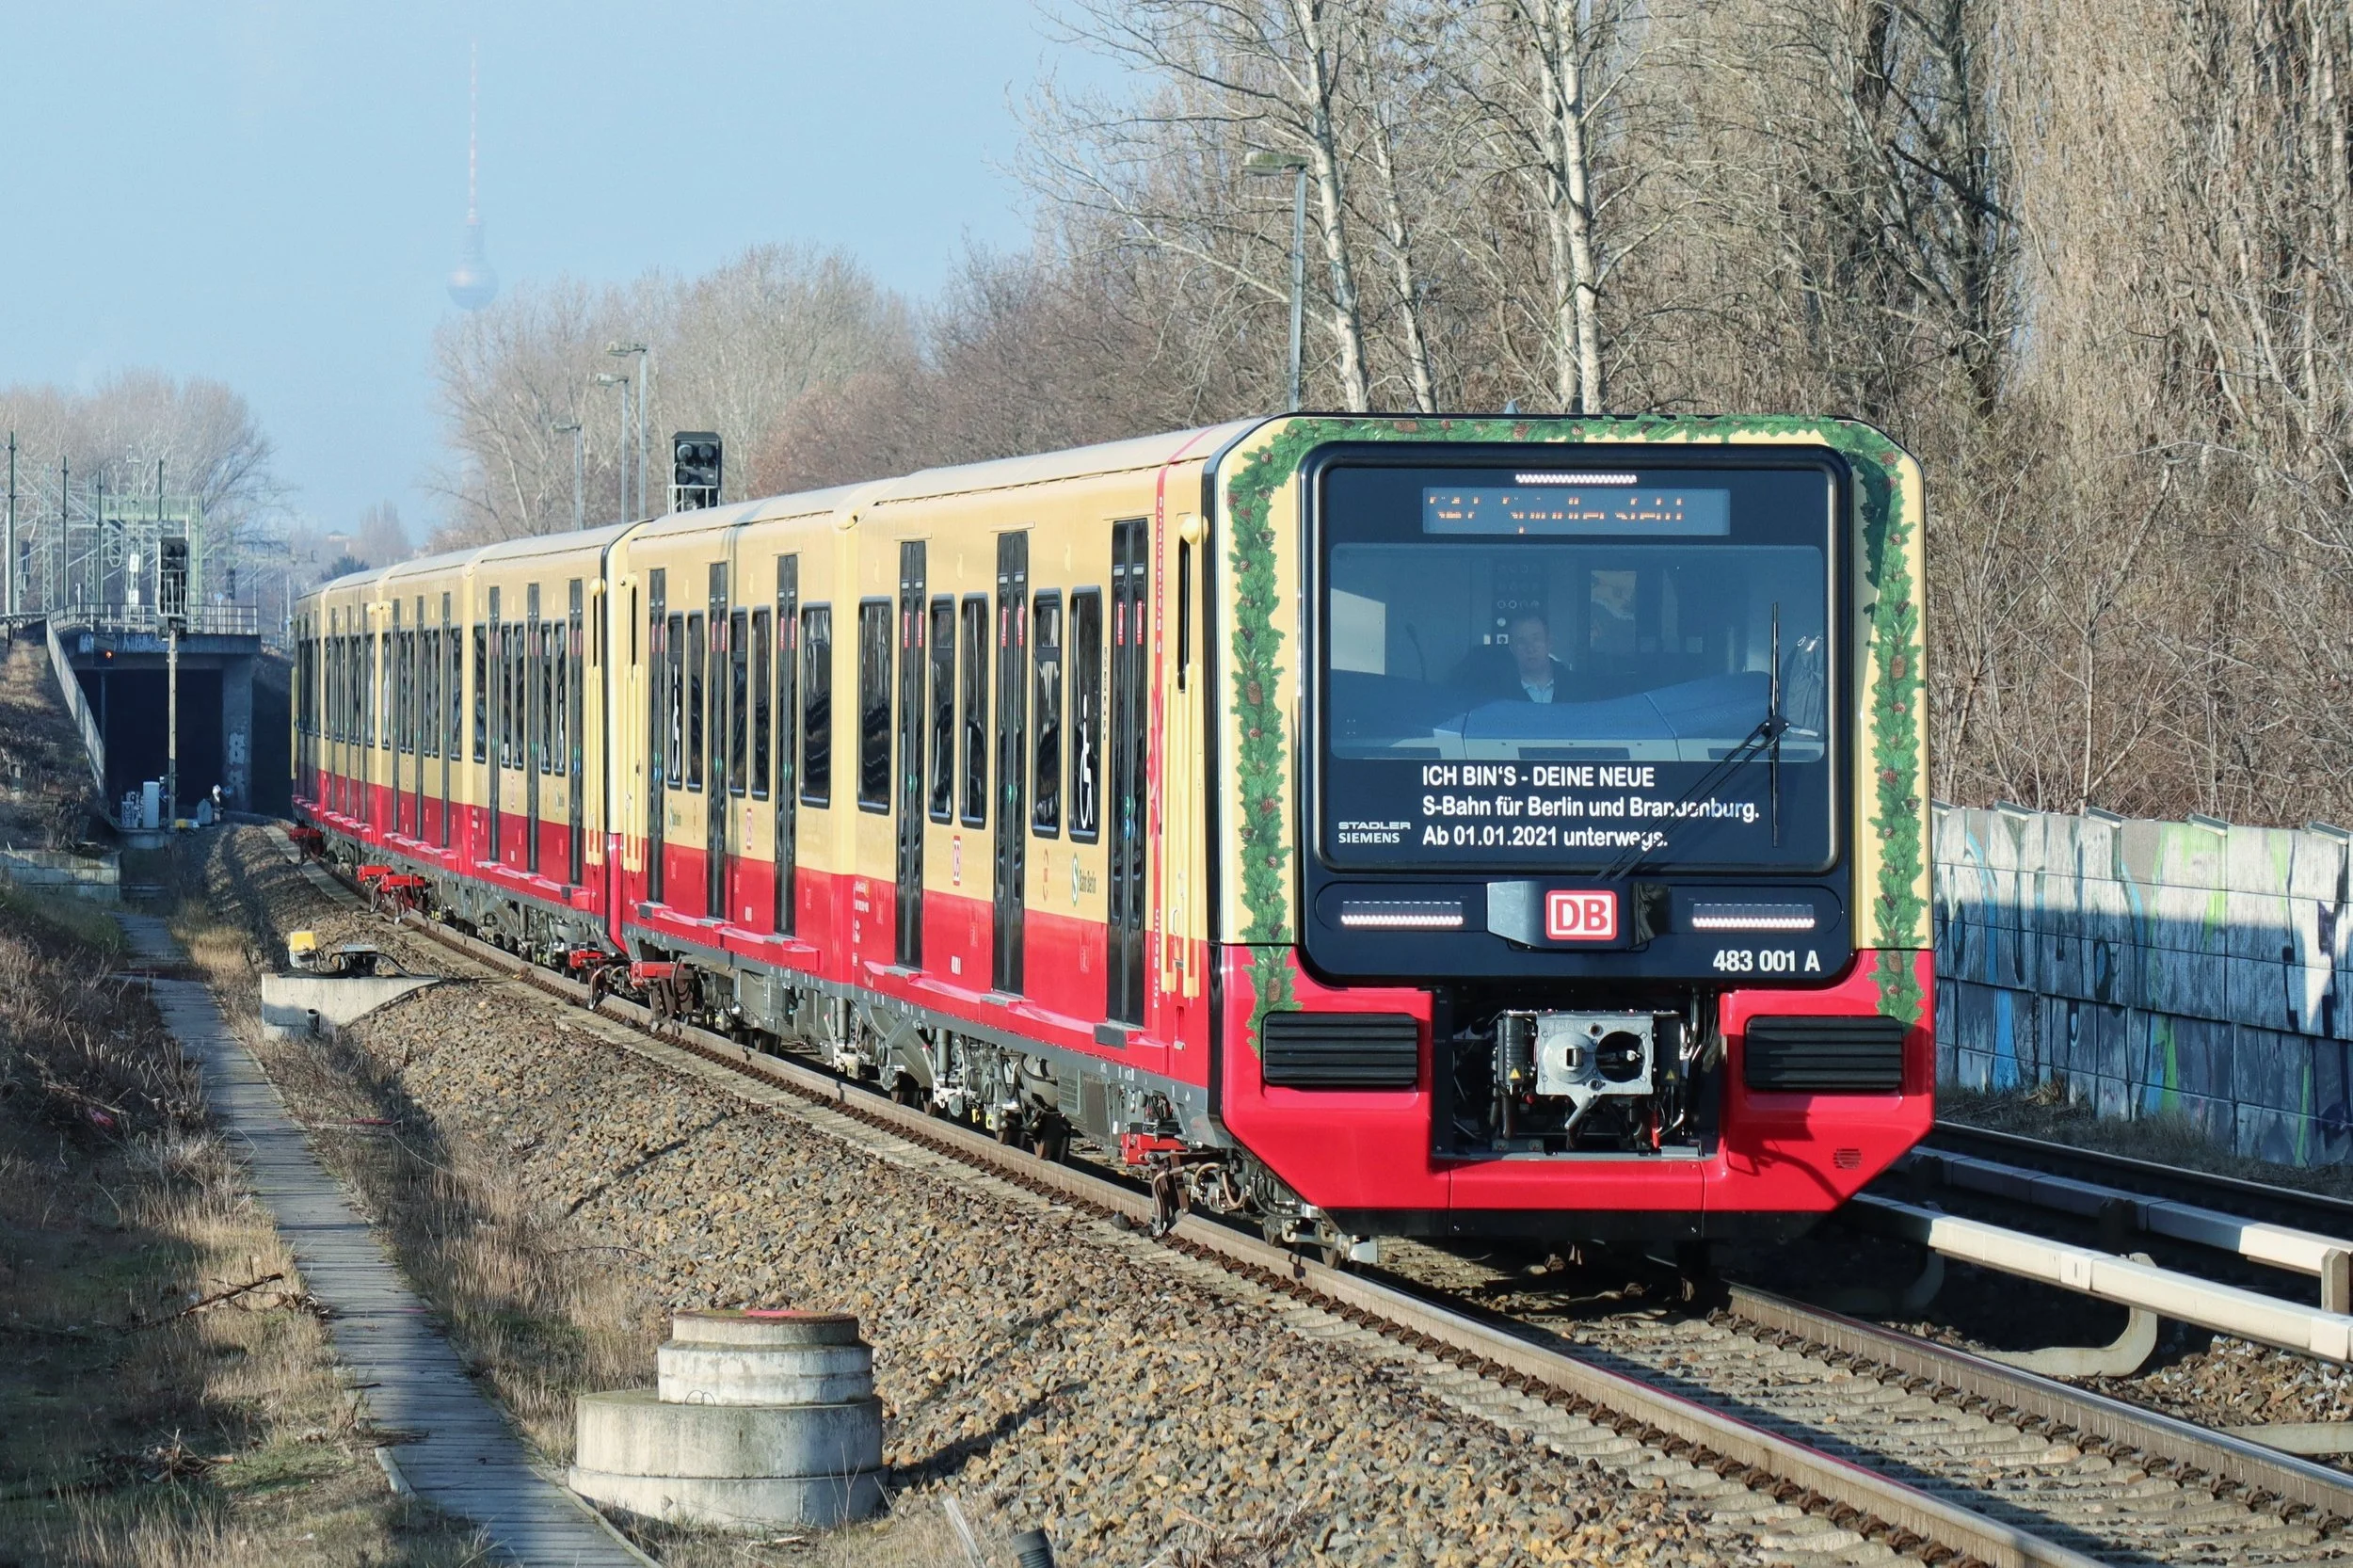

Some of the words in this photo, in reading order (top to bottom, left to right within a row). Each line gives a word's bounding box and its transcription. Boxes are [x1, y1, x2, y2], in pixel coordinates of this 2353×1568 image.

[1422, 764, 1458, 787] ICH
[1532, 765, 1594, 787] DEINE
[1599, 766, 1656, 788] NEUE
[1422, 794, 1491, 817] S-Bahn
[1495, 795, 1524, 817] für
[1528, 795, 1584, 817] Berlin
[1588, 795, 1625, 818] und
[1337, 821, 1412, 830] STADLER
[1422, 824, 1449, 846] Ab
[1453, 824, 1557, 846] 01.01.2021
[1337, 832, 1401, 844] SIEMENS
[1555, 898, 1609, 932] DB
[1712, 949, 1753, 972] 483
[1758, 949, 1796, 972] 001
[1803, 949, 1821, 972] A
